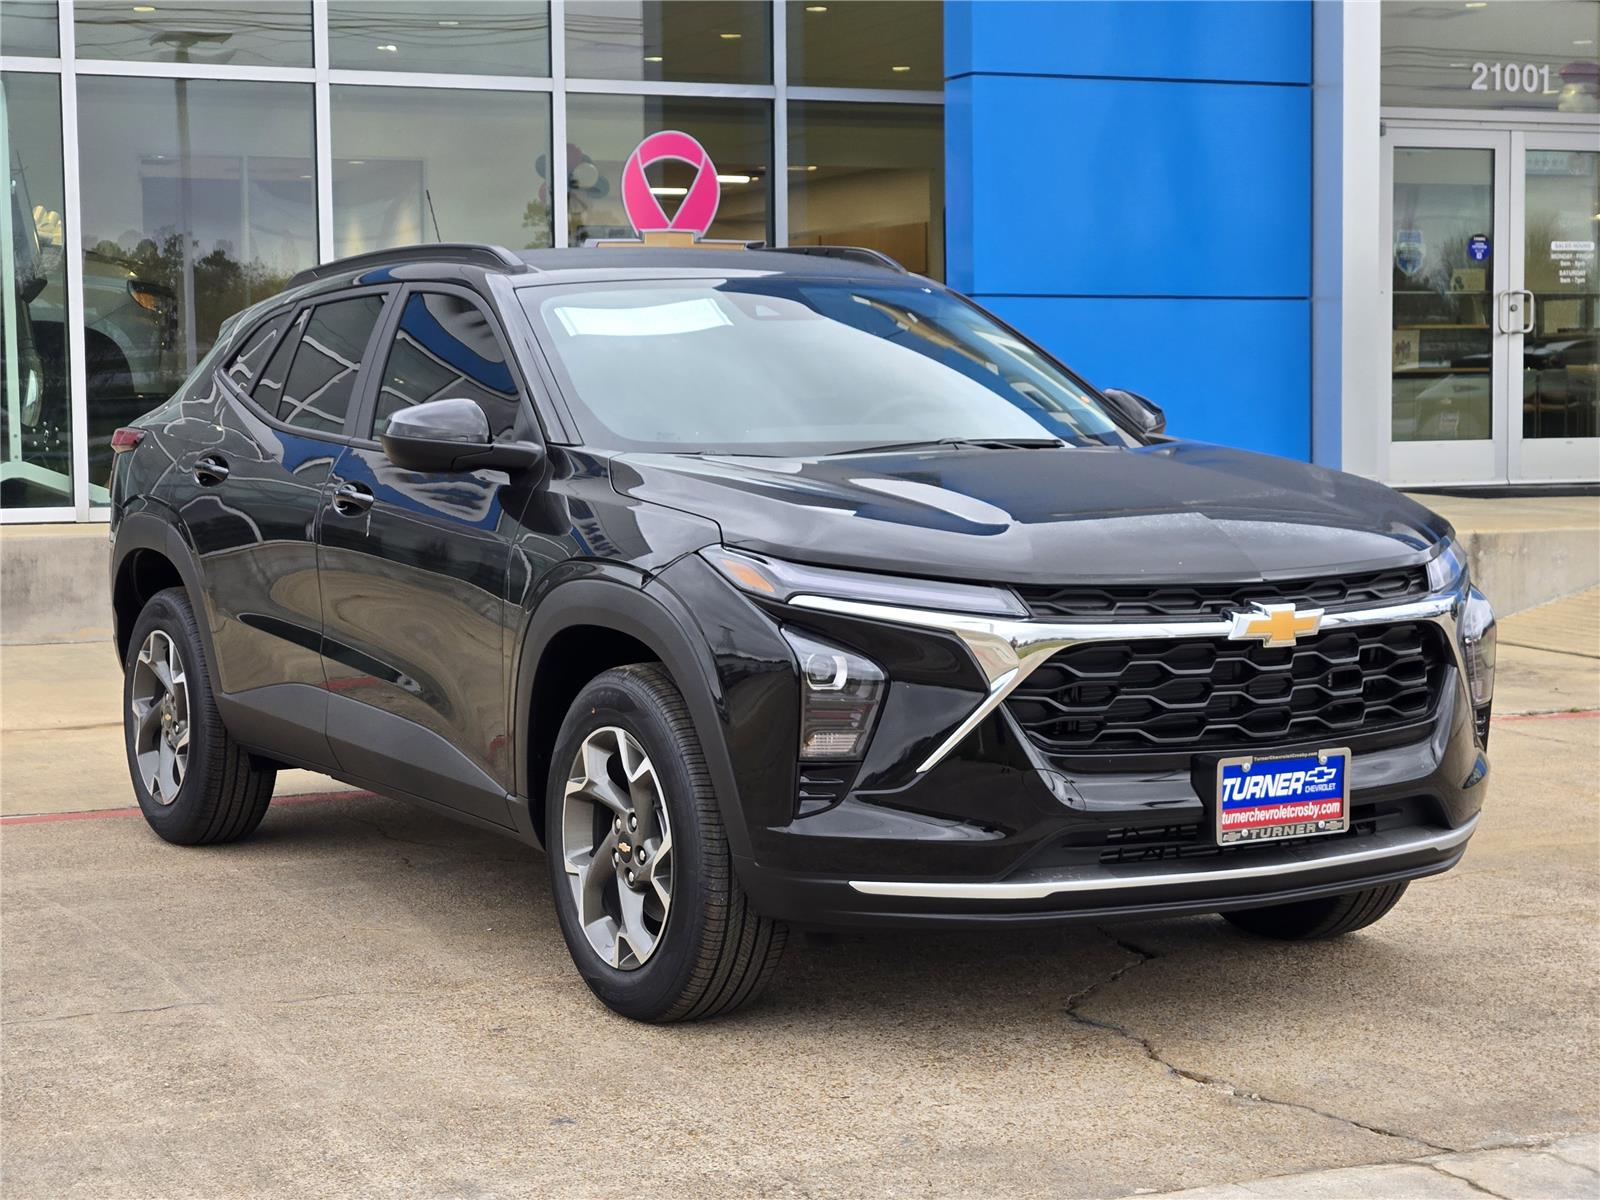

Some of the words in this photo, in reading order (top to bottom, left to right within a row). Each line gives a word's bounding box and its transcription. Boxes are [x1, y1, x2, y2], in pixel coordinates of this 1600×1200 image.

[1471, 62, 1551, 93] 21001
[1223, 771, 1305, 801] TURNER
[1305, 782, 1336, 793] CHEVROLET
[1222, 802, 1340, 825] turnerchevroletcrosby.com
[1250, 823, 1316, 839] TURNER
